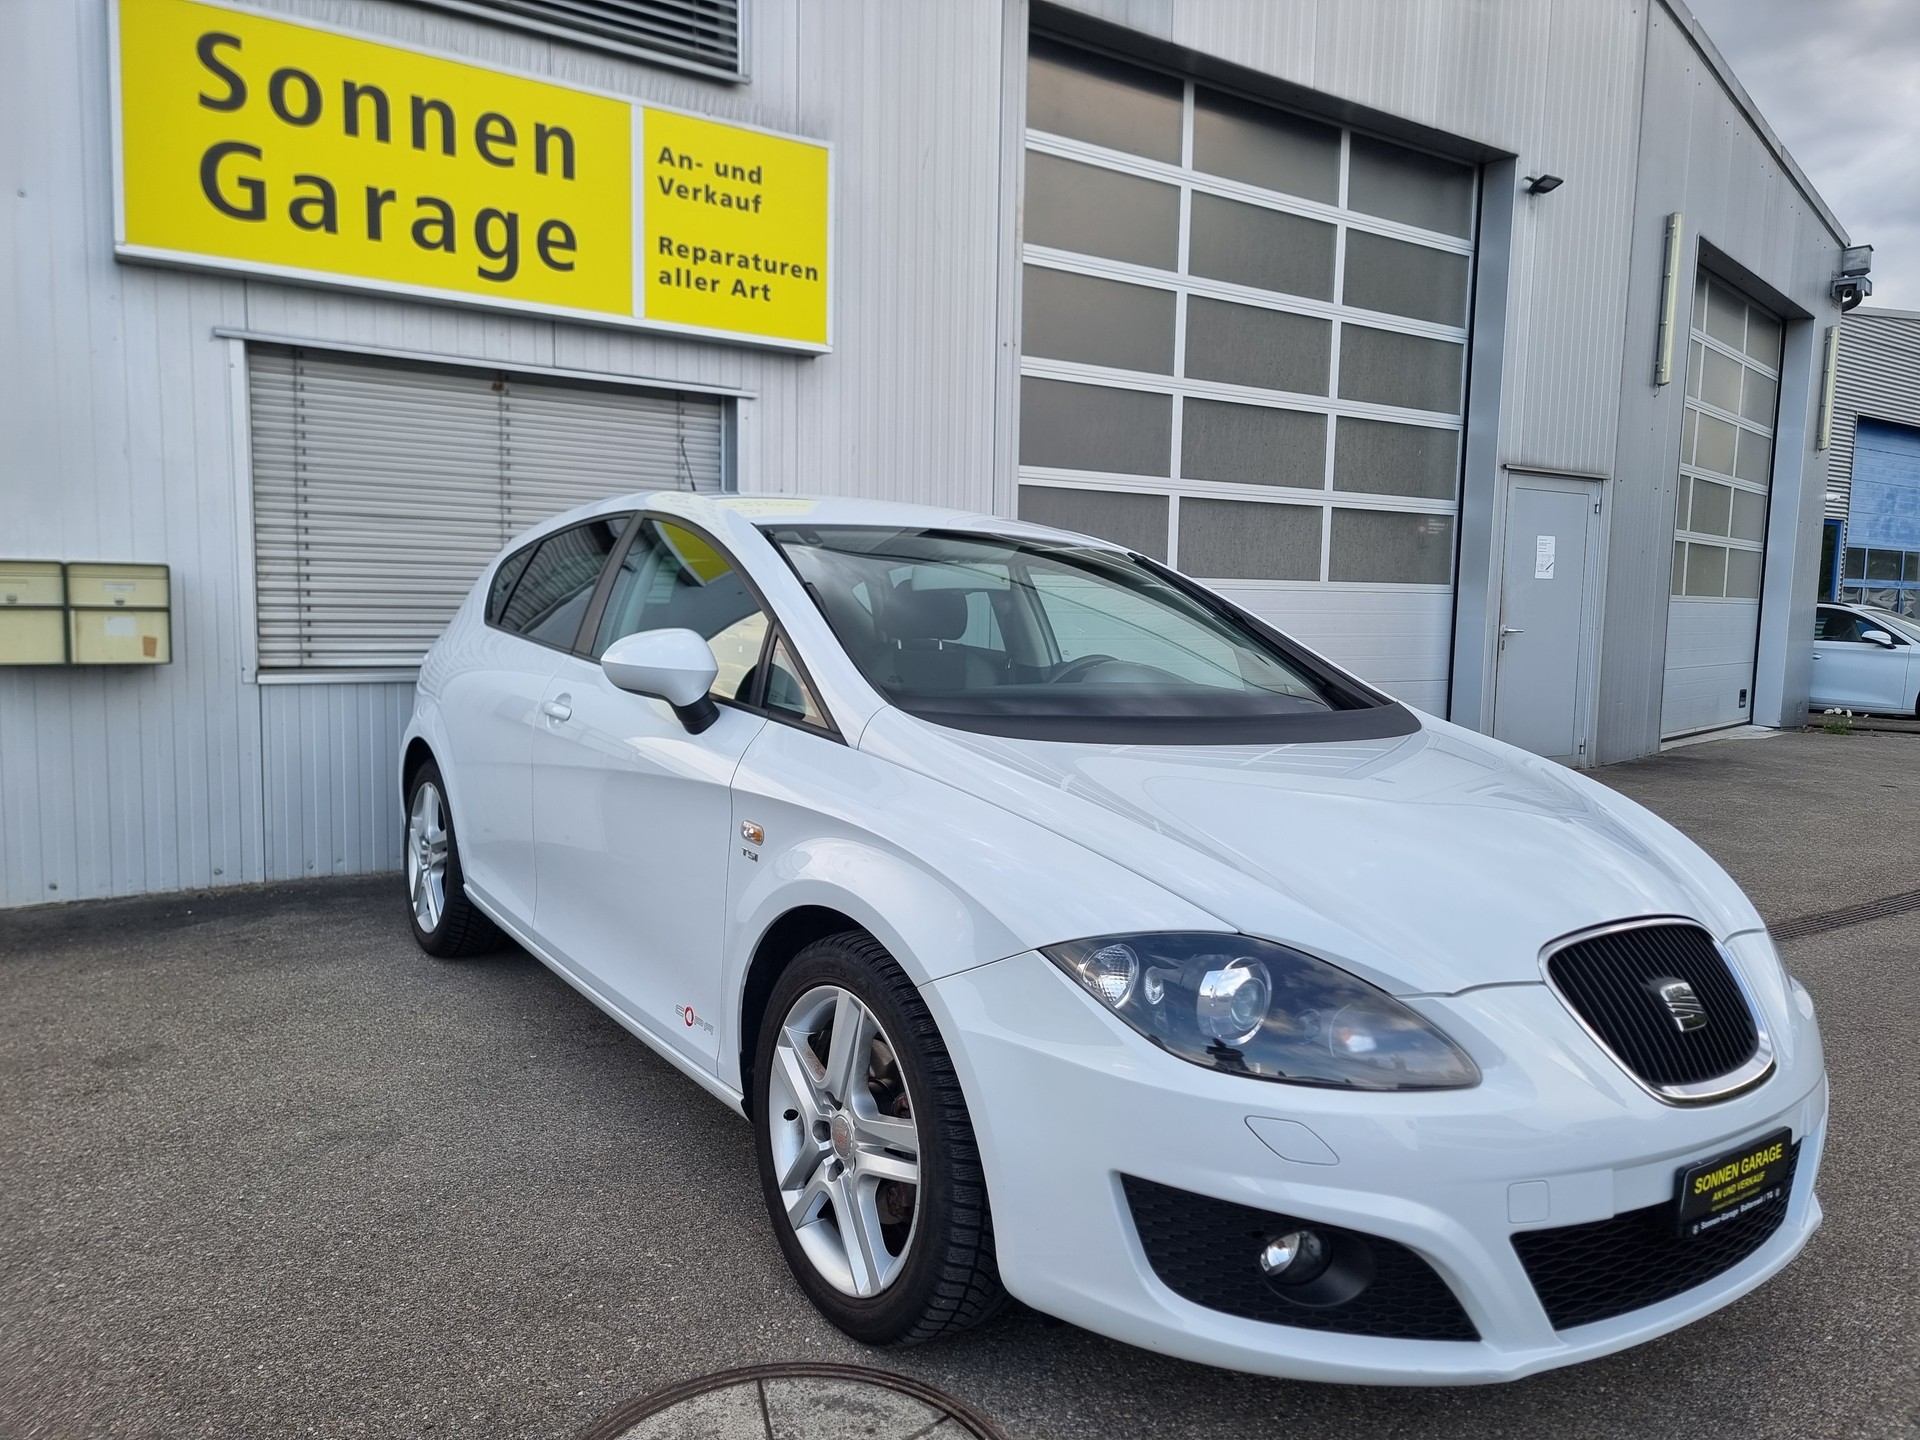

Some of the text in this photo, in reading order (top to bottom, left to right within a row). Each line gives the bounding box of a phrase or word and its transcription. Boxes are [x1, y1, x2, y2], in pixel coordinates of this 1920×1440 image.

[194, 31, 576, 181] Sonnen
[657, 146, 763, 186] An- und
[199, 140, 578, 283] Garage
[657, 175, 763, 214] Verkauf
[658, 235, 819, 282] Reparaturen
[658, 267, 771, 302] aller Art
[1694, 1144, 1782, 1194] SONNEN GARAGE
